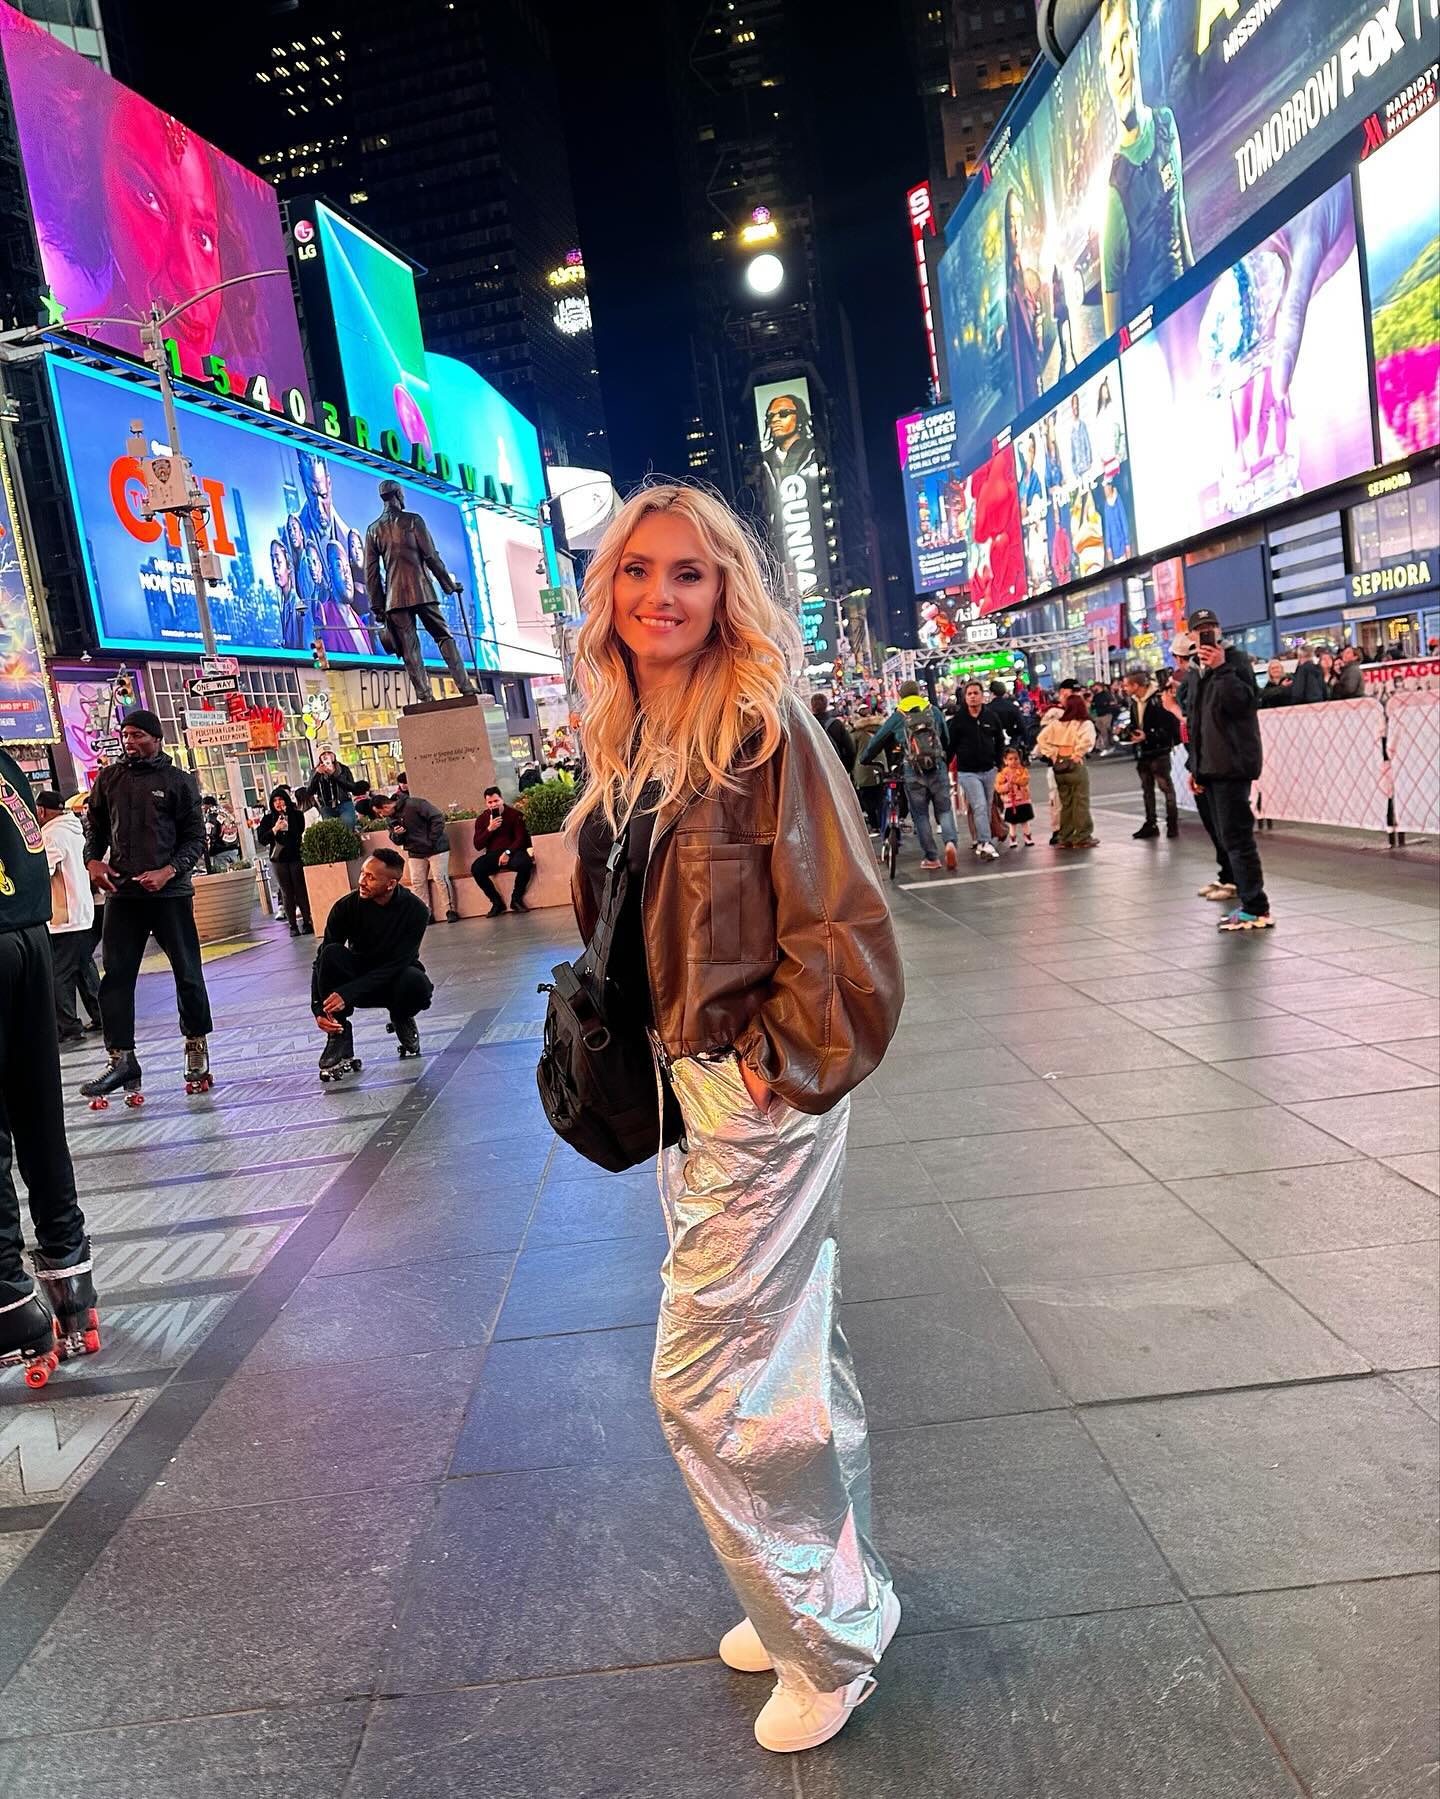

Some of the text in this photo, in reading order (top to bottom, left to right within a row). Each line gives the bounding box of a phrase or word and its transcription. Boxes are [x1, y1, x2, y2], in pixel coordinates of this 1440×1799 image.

[1234, 54, 1338, 193] TOMORROW
[1340, 0, 1405, 98] FOX
[1386, 63, 1440, 119] MARRIOTT
[1386, 87, 1436, 137] MARQUIS
[297, 243, 317, 261] LG
[164, 338, 514, 505] 1540 BROADWAY
[905, 419, 925, 435] THE
[906, 433, 920, 445] OF
[920, 430, 929, 441] A
[1367, 471, 1412, 498] SEPHORA
[780, 474, 818, 594] GUNNA
[1352, 560, 1431, 597] SEPHORA
[971, 628, 993, 639] BT21
[196, 680, 232, 692] ONE WAY
[360, 669, 411, 710] FOREV
[195, 724, 247, 737] PEDESTRIAN FLOW ZONE
[231, 732, 248, 740] MOVING
